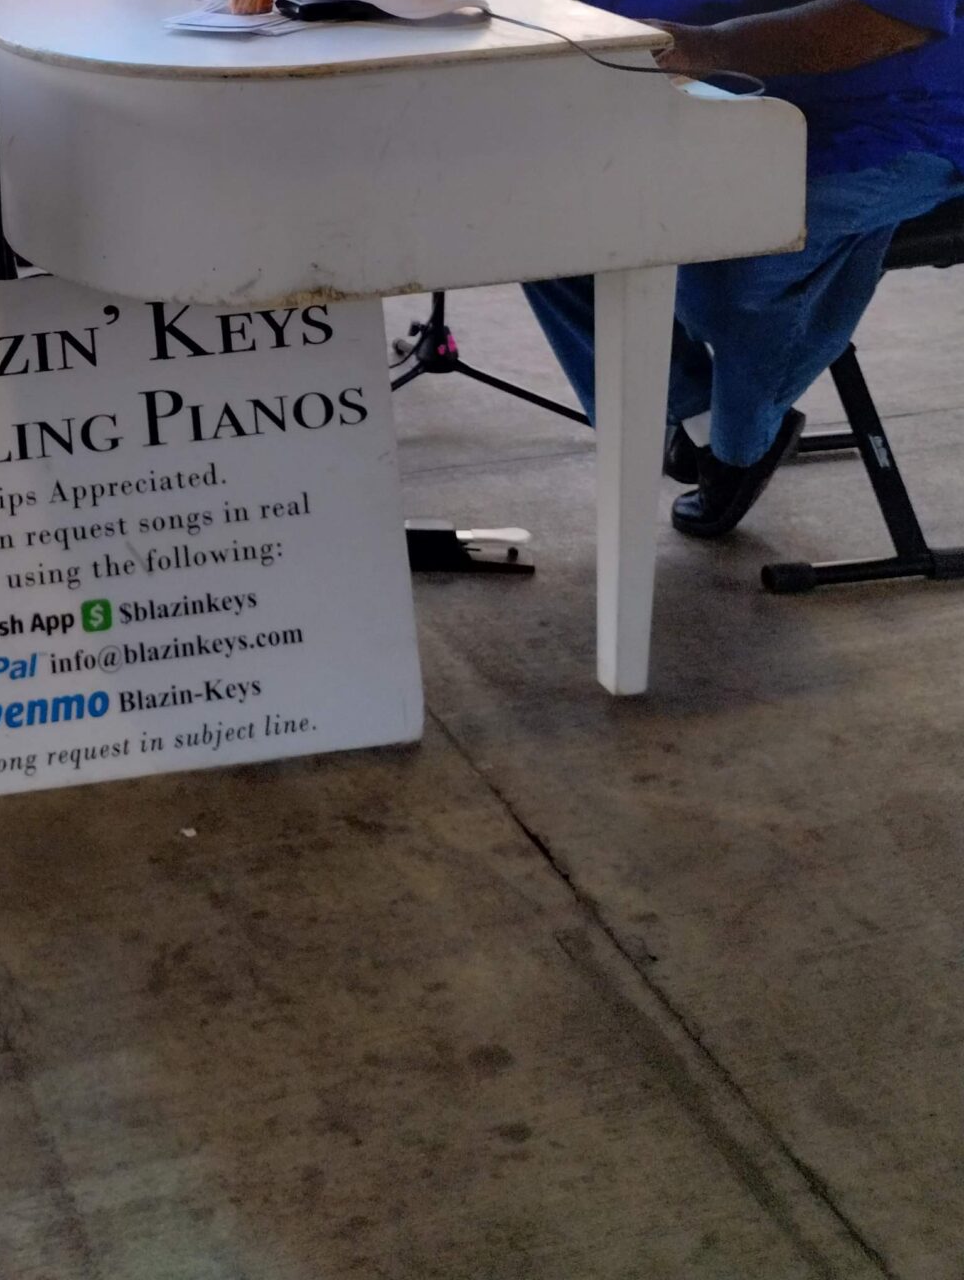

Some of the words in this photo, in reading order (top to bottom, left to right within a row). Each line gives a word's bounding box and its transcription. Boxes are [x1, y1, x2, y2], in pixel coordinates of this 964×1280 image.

[145, 300, 334, 361] KEYS
[139, 387, 368, 446] PIANOS
[50, 462, 228, 509] Appreciated.
[27, 518, 126, 550] request
[140, 512, 213, 535] songs
[225, 502, 249, 523] in
[261, 492, 310, 519] real
[7, 563, 80, 589] using
[92, 554, 135, 578] the
[147, 540, 282, 572] following:
[30, 613, 74, 636] App
[119, 593, 257, 624] $blazinkeys
[51, 628, 303, 674] info@blazinkeys.com
[119, 679, 261, 712] Blazin-Keys
[48, 739, 128, 769] request
[141, 732, 163, 752] in
[175, 722, 254, 750] subject
[265, 714, 316, 736] line.
